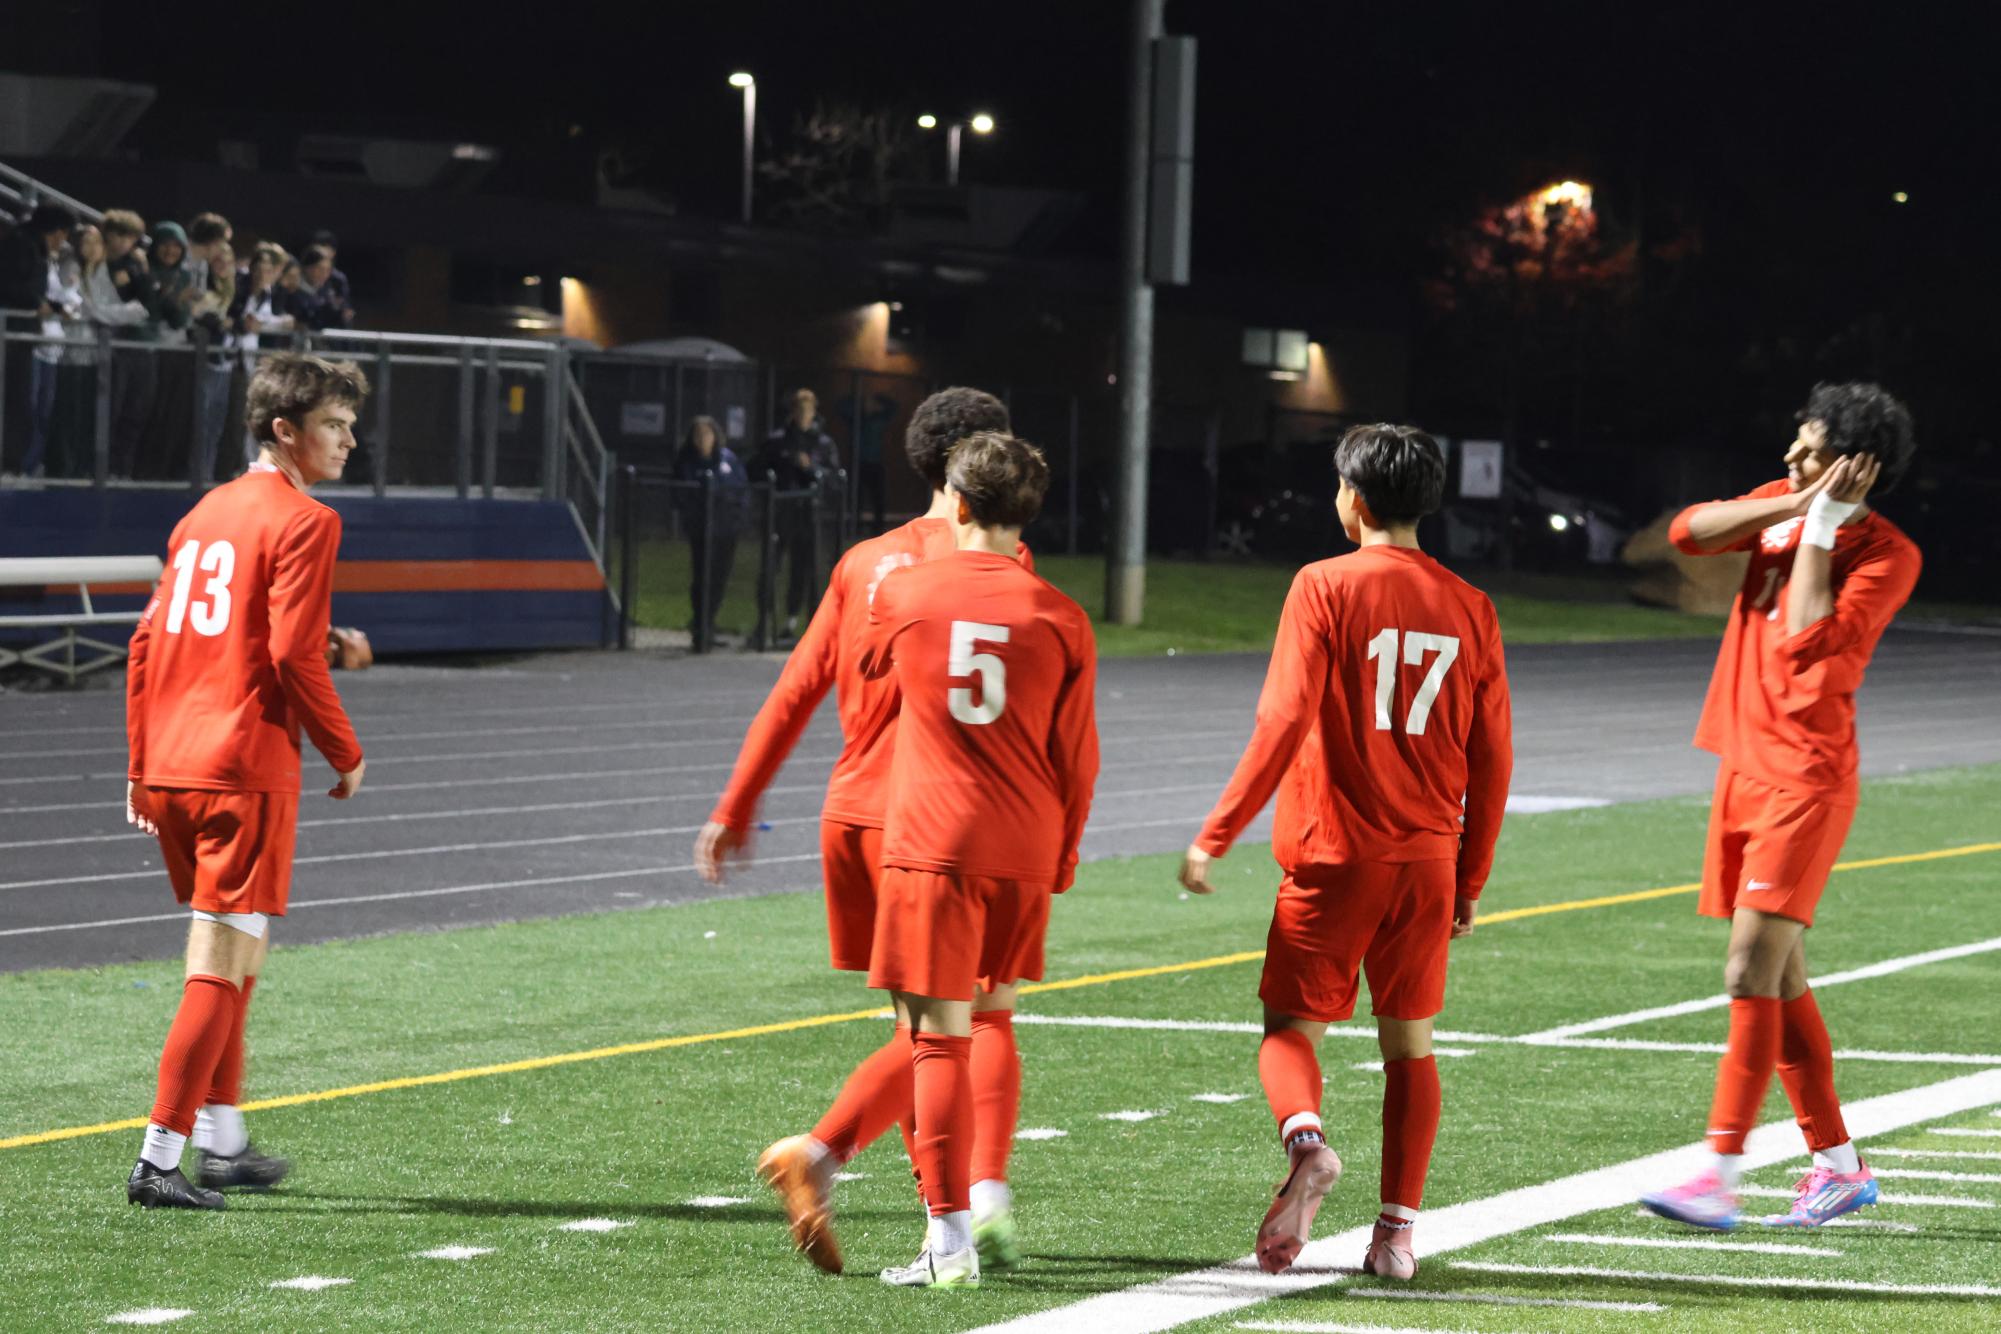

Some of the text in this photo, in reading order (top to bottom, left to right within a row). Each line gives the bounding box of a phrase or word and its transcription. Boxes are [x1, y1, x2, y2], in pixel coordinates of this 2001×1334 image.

[165, 538, 237, 637] 13
[946, 620, 1010, 726] 5
[1365, 627, 1460, 737] 17
